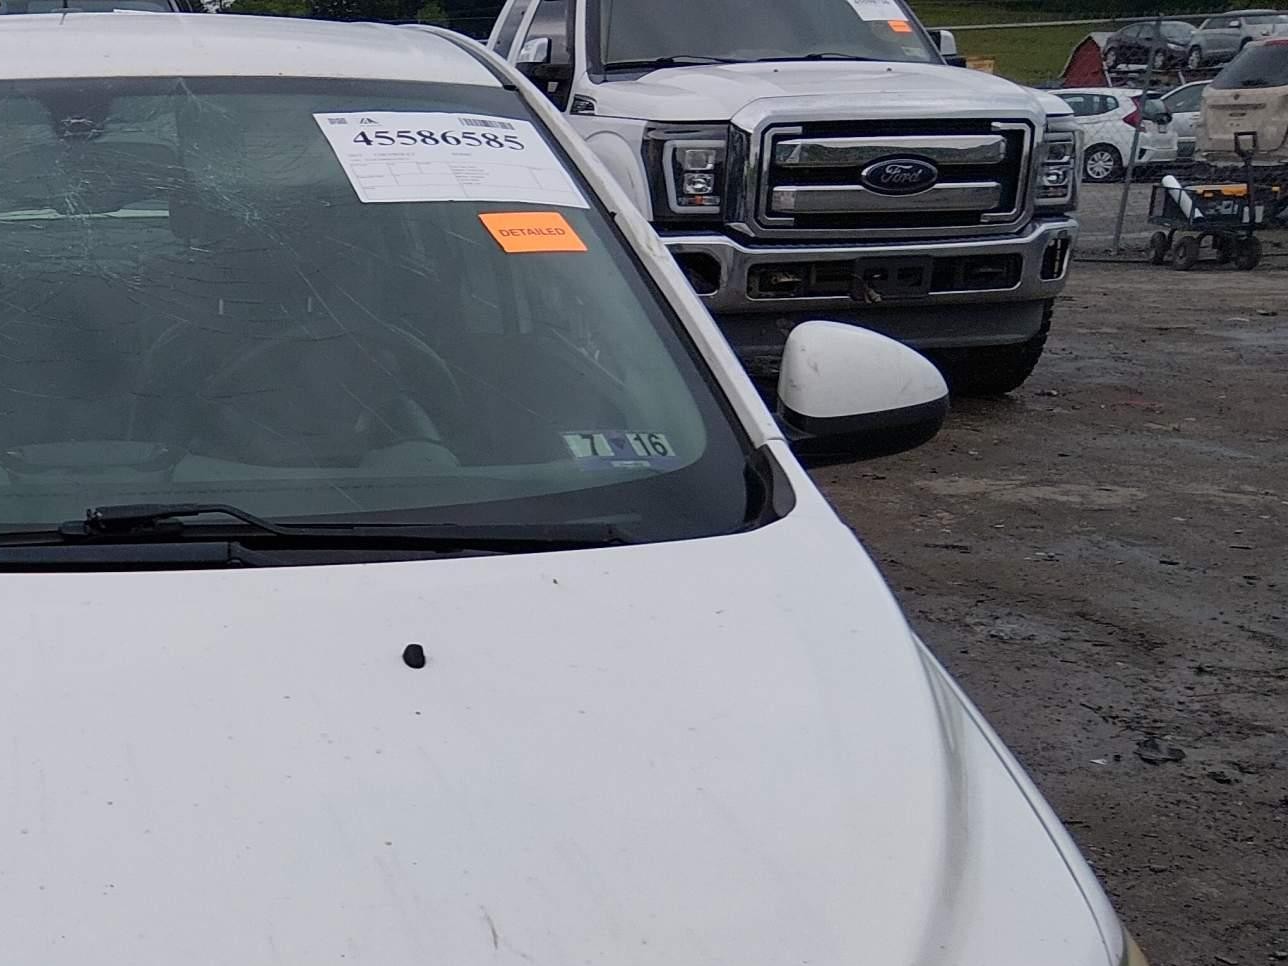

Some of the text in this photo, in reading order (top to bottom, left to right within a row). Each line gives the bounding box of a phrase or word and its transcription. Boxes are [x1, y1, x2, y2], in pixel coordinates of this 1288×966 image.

[353, 129, 525, 151] 45586585
[880, 164, 923, 183] Ford
[498, 228, 566, 237] DETAILED
[580, 434, 668, 456] 7 16
